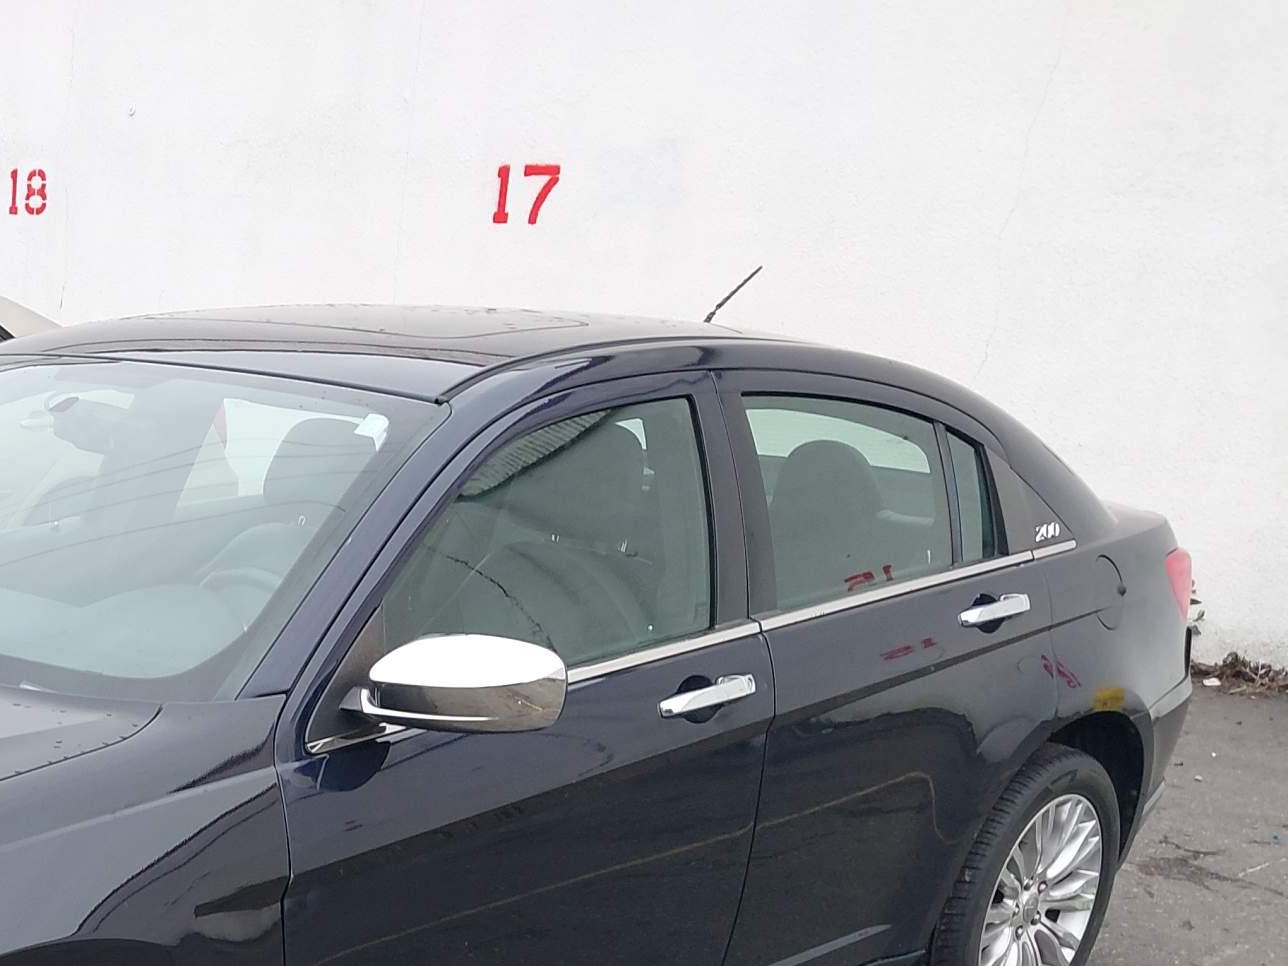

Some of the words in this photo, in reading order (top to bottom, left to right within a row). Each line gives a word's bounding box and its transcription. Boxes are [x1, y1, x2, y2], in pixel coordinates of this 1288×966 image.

[9, 169, 47, 216] 18
[492, 163, 562, 225] 17
[1035, 522, 1060, 542] 200
